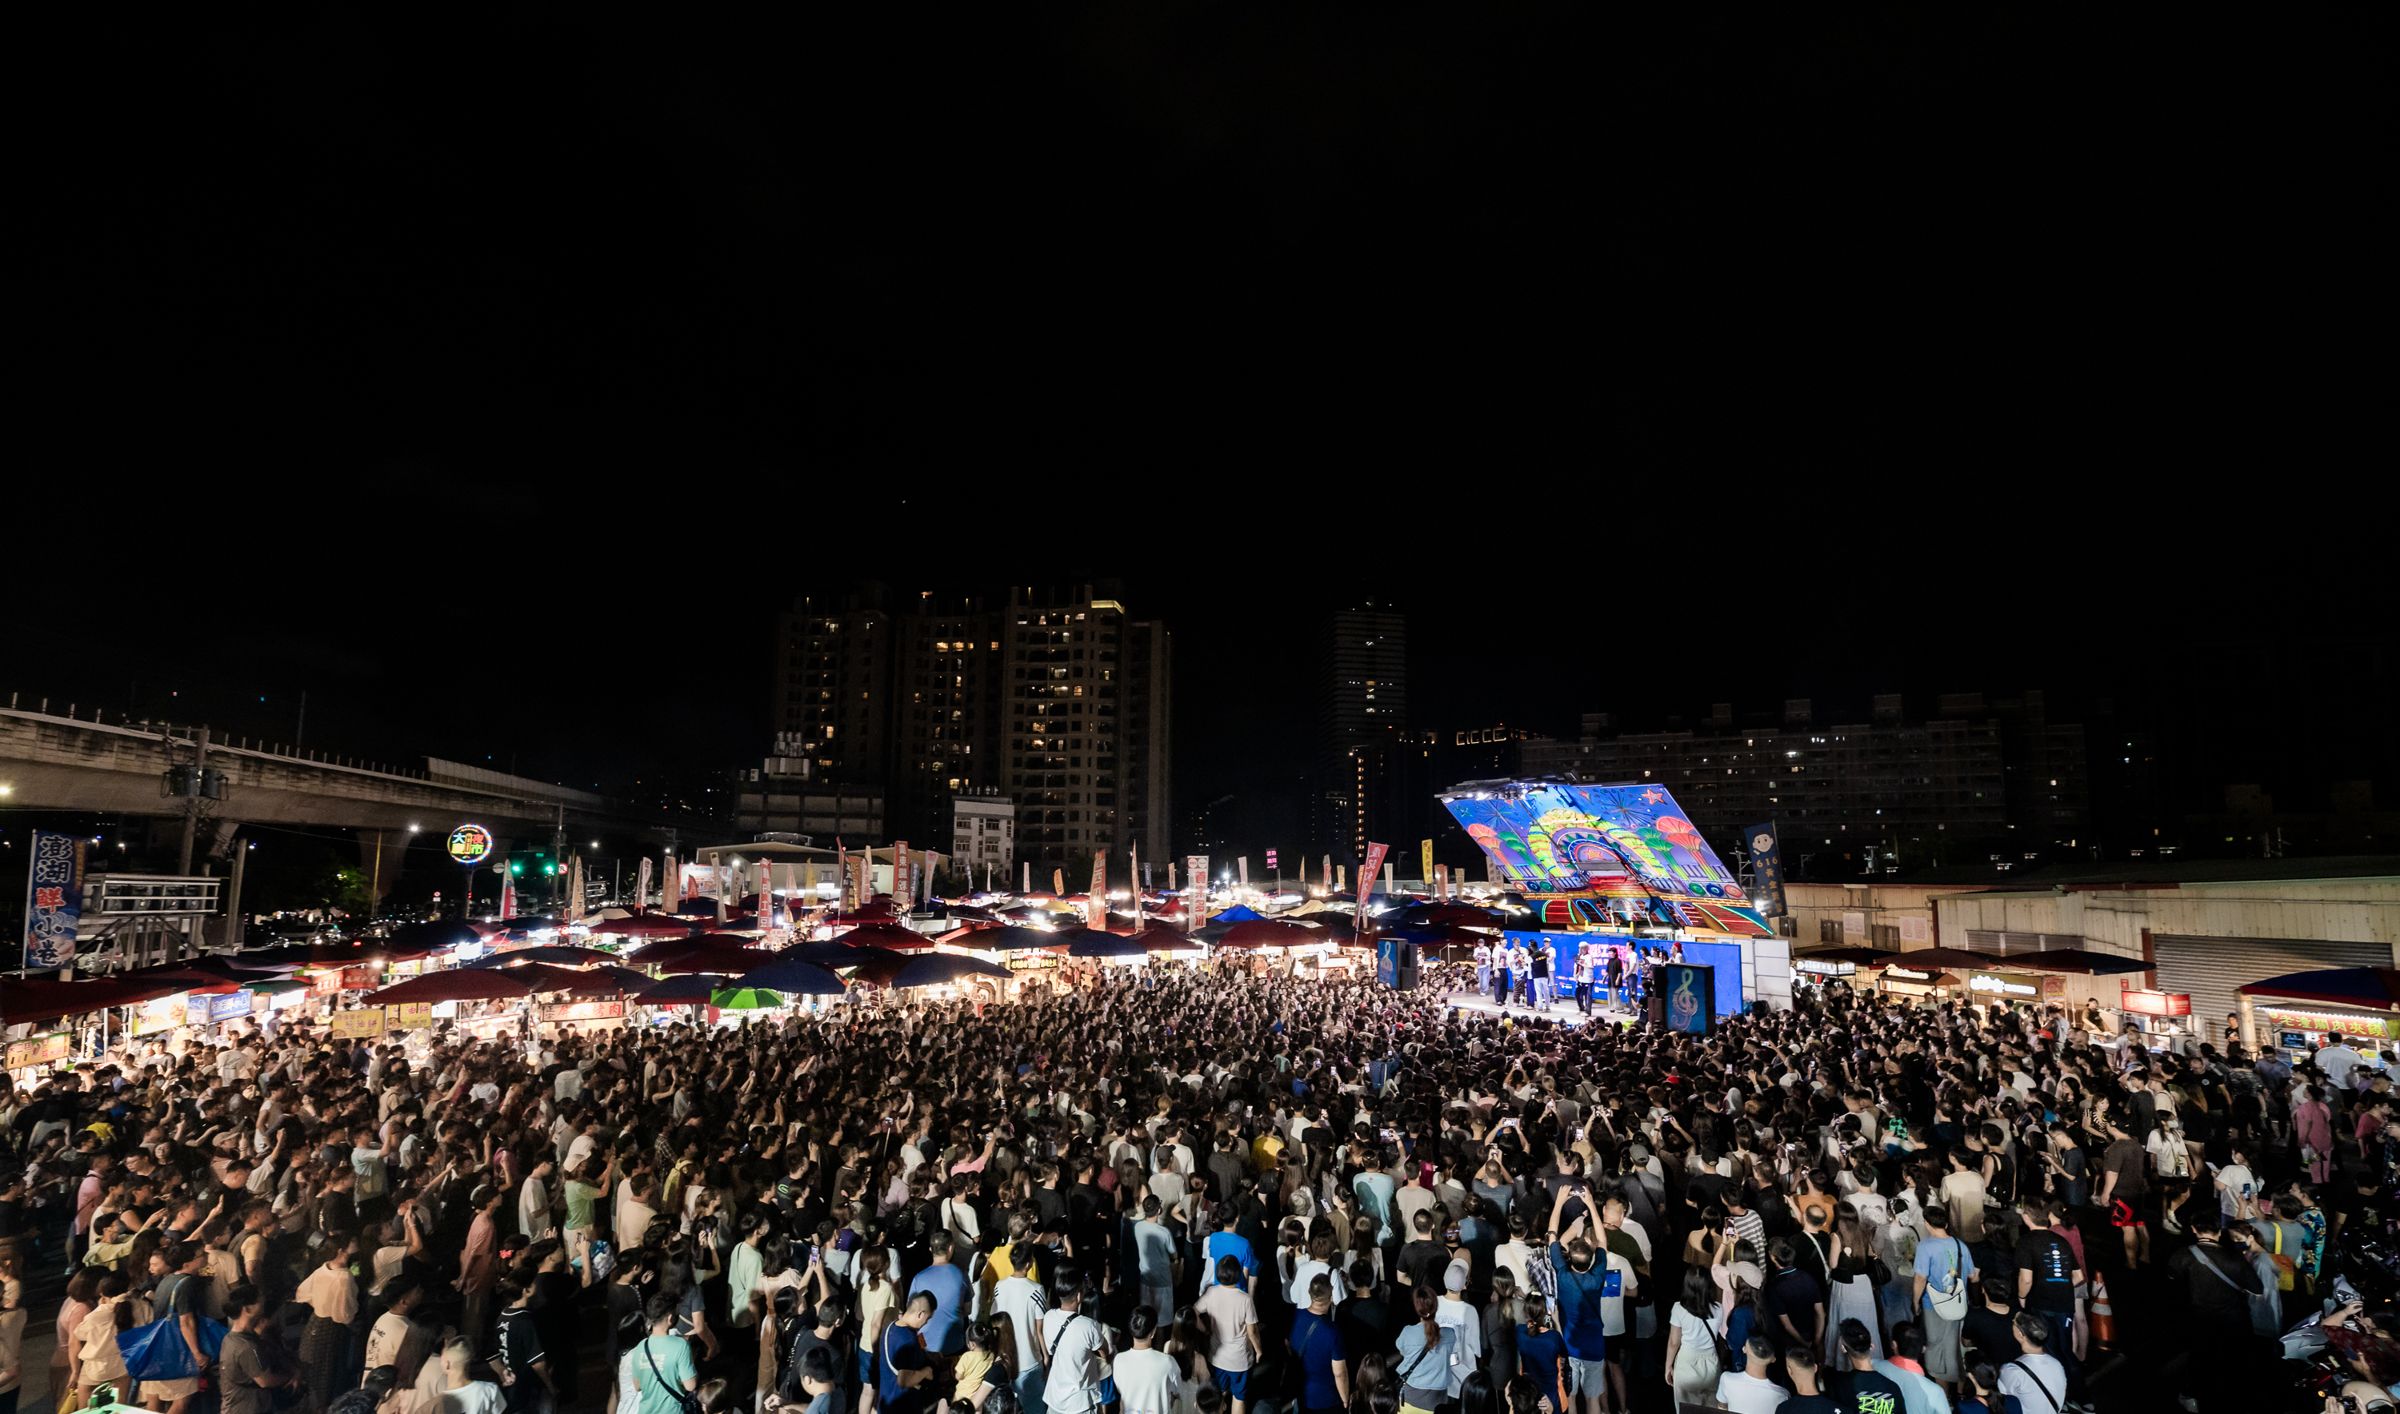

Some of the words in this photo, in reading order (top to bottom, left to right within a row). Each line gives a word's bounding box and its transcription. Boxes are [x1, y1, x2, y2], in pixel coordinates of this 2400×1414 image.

[1756, 856, 1779, 868] 616
[35, 835, 74, 967] 澎湖鮮小卷
[1858, 1396, 1895, 1414] RUN
